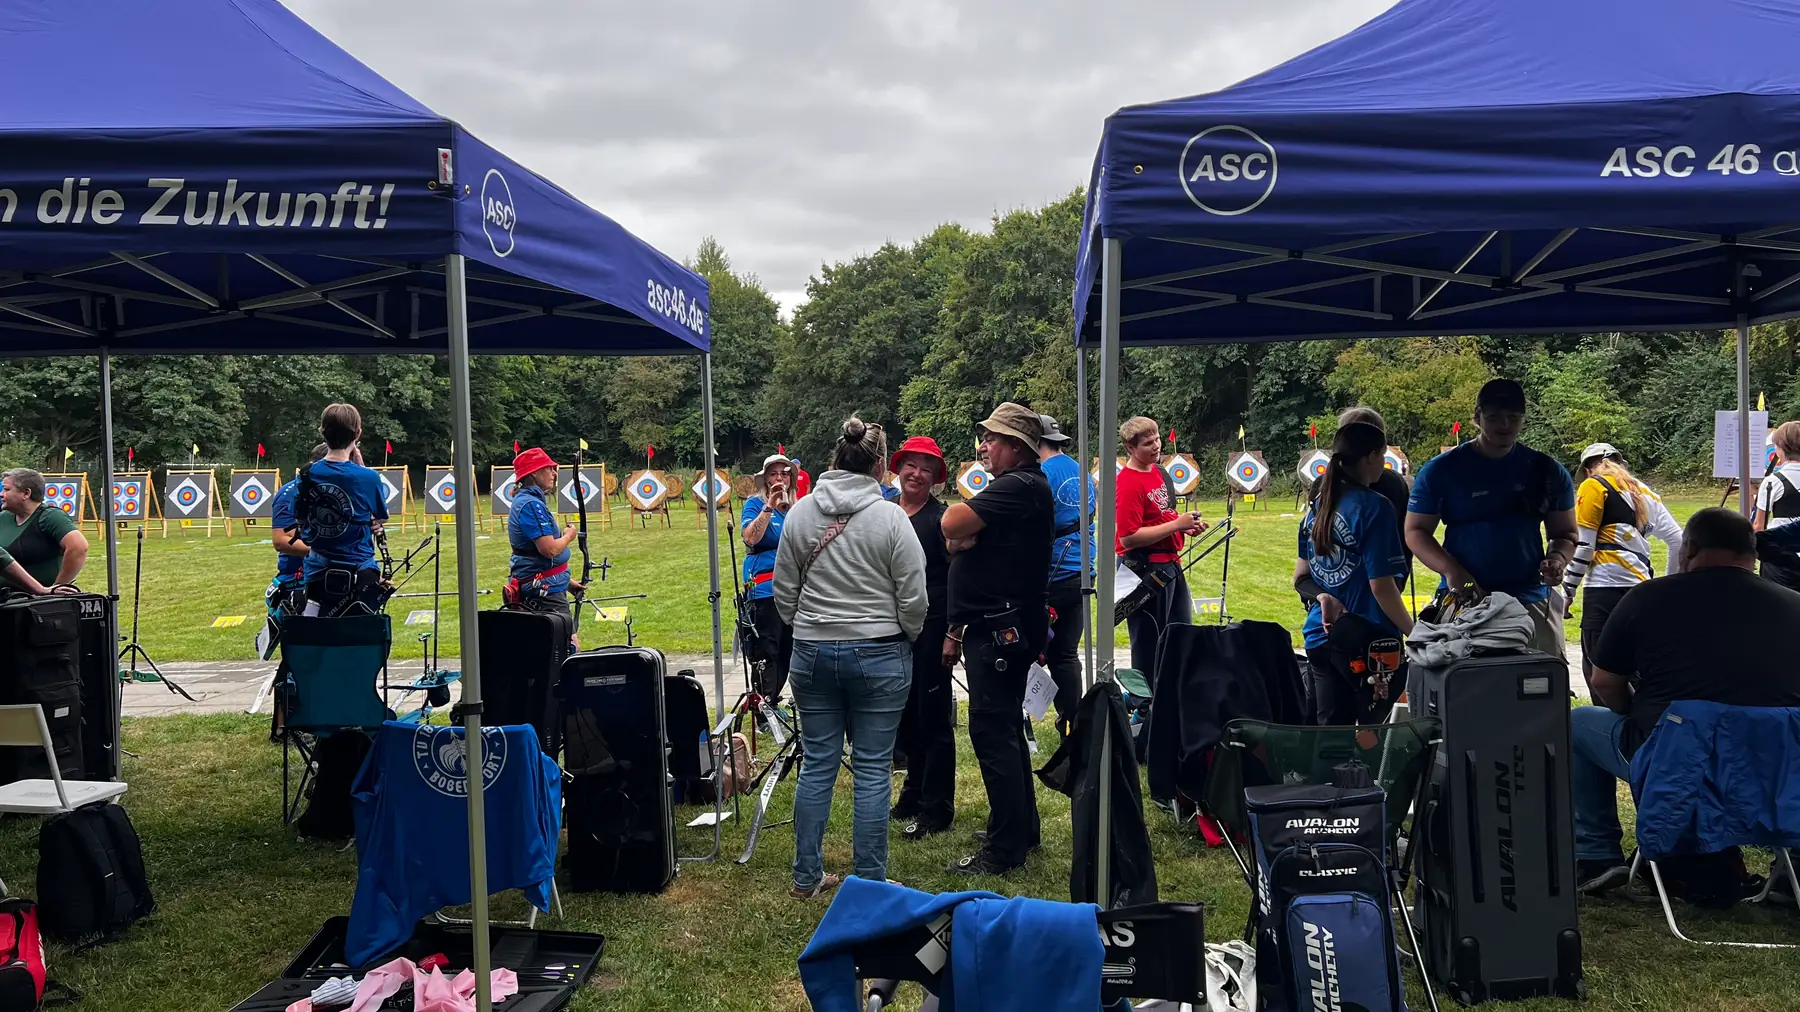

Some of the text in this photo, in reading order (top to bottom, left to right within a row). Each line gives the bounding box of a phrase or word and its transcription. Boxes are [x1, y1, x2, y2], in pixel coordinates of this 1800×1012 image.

[1190, 153, 1267, 182] ASC
[1600, 145, 1695, 178] ASC
[1707, 143, 1761, 176] 46
[37, 177, 125, 225] die
[139, 178, 395, 229] Zukunft!
[487, 197, 513, 230] ASC
[647, 279, 704, 335] asc46.de
[412, 614, 432, 624] 12
[1200, 602, 1220, 614] 16
[763, 777, 776, 798] HOYT
[1285, 817, 1360, 829] AVALON
[1304, 827, 1360, 835] ARCHERY
[1494, 760, 1518, 913] AVALON
[1299, 867, 1358, 877] CLASSIC
[1303, 921, 1329, 1012] ALON
